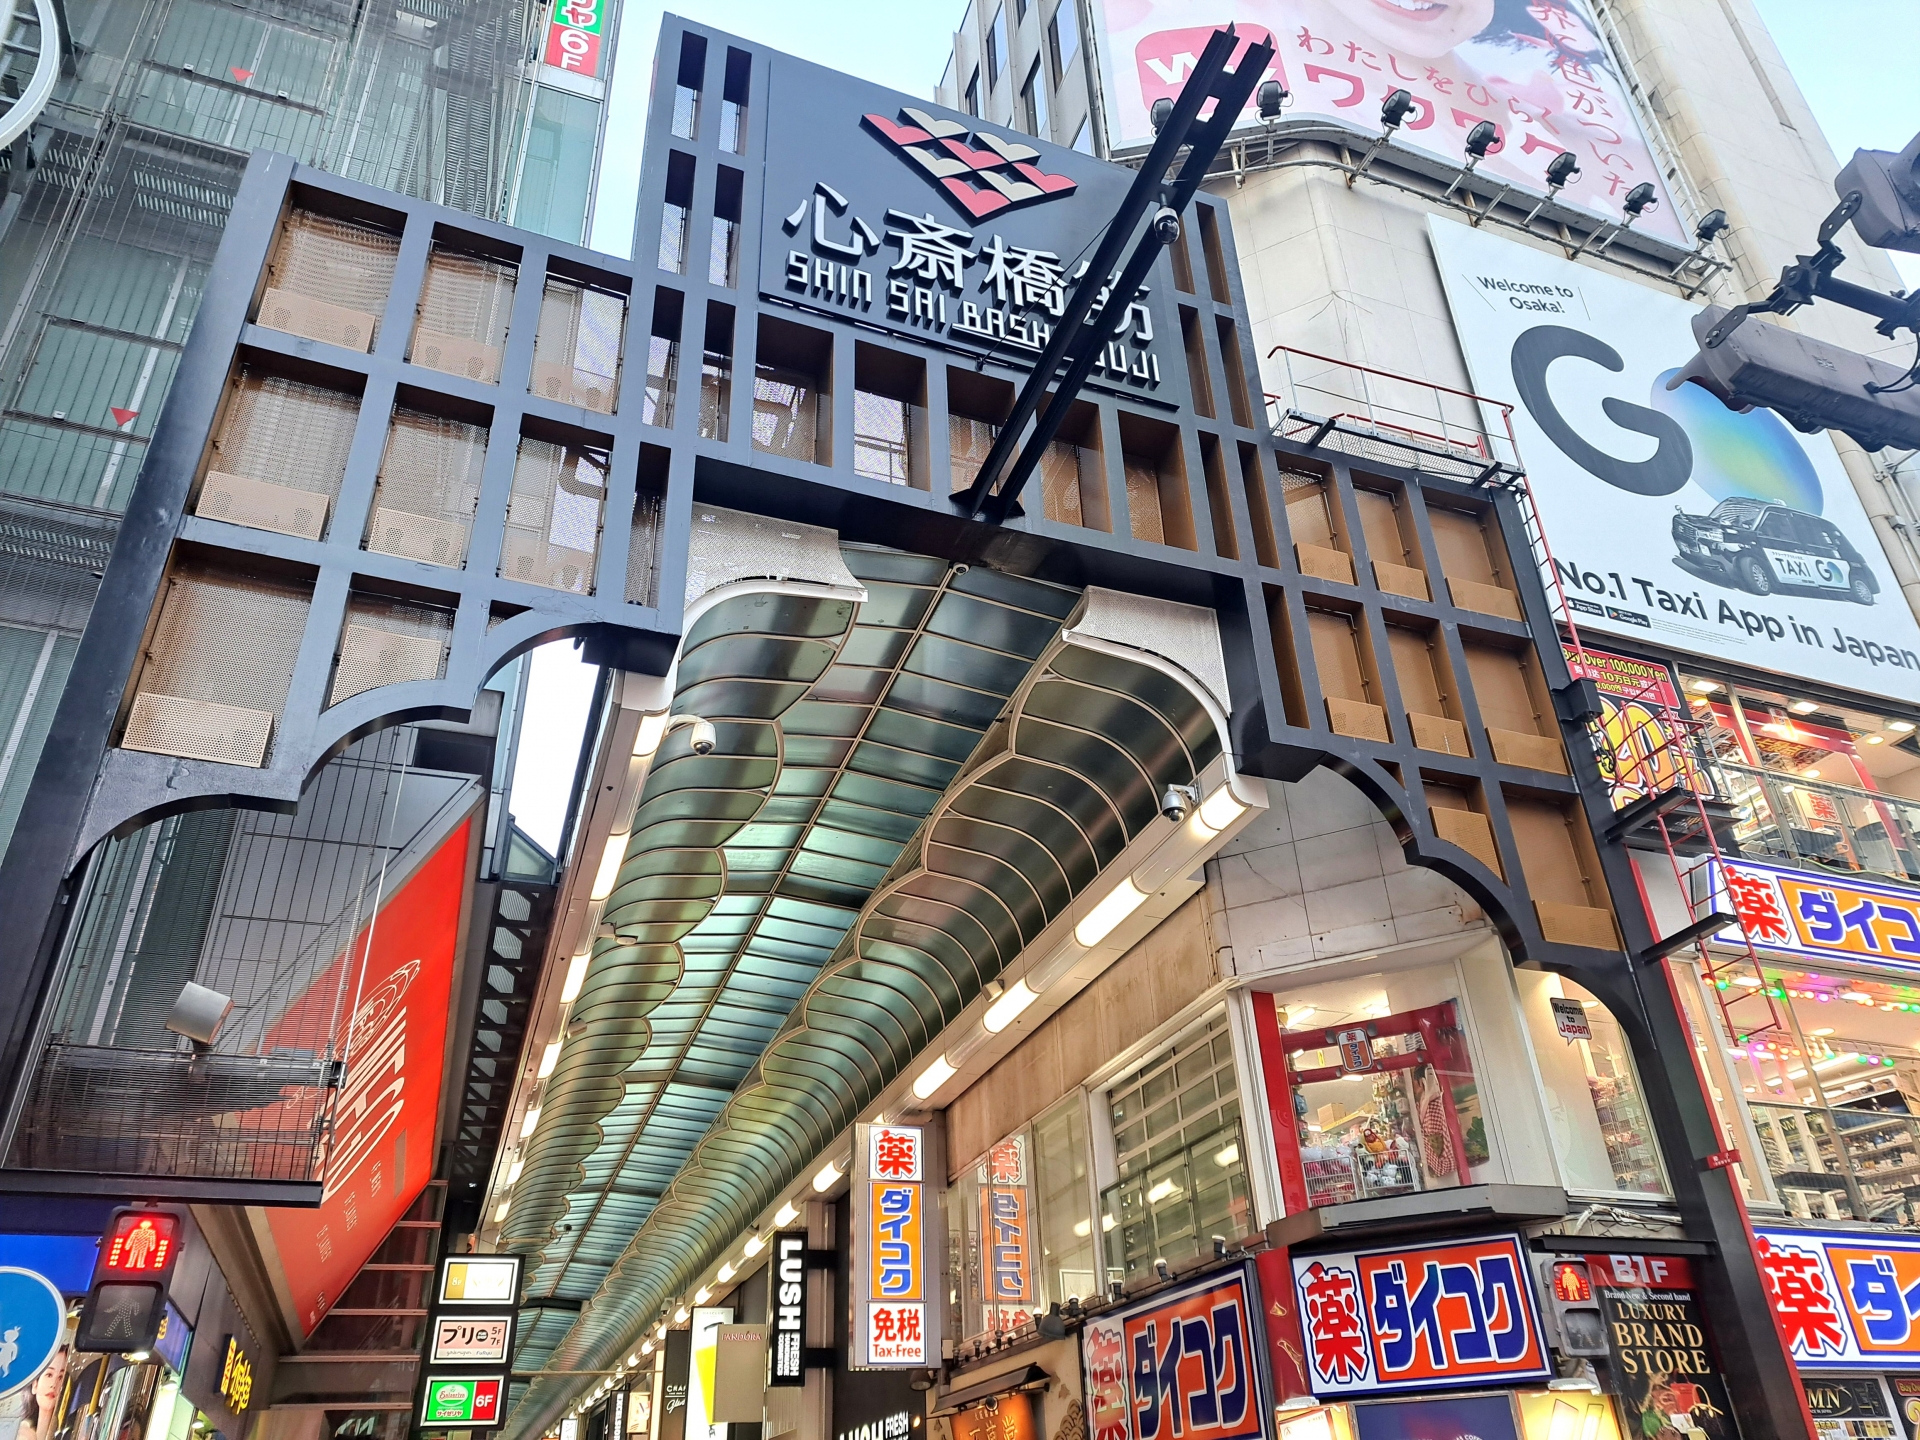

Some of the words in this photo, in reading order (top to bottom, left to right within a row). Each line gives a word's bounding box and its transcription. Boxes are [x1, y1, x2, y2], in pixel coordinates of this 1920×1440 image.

[560, 29, 590, 69] 6F
[1296, 26, 1560, 135] わたしをひらく
[787, 249, 873, 306] SHIN
[889, 280, 947, 328] SAI
[954, 300, 1054, 348] BASH
[1477, 275, 1555, 298] Welcome
[1558, 285, 1574, 299] to
[1508, 295, 1567, 315] Osaka!
[1775, 557, 1812, 578] TAXI
[1552, 557, 1628, 601] No.1
[1631, 577, 1709, 621] Taxi
[1718, 599, 1786, 643] App
[1788, 614, 1824, 650] in
[1832, 628, 1920, 673] Japan
[1562, 648, 1581, 664] Buy
[1584, 653, 1607, 668] Over
[1609, 658, 1649, 678] 100,000
[1648, 666, 1668, 682] Yen
[1721, 865, 1789, 943] 薬
[1797, 888, 1920, 955] ダイコ
[1552, 1003, 1584, 1016] Welcome
[1566, 1015, 1576, 1023] to
[1560, 1020, 1590, 1035] Japan
[877, 1129, 915, 1177] 薬
[880, 1187, 913, 1295] ダイコク
[1609, 1254, 1669, 1283] B1F
[451, 1276, 463, 1287] 8F
[779, 1239, 803, 1330] LUSH
[1756, 1237, 1843, 1351] 薬
[1846, 1254, 1920, 1346] ダ
[1604, 1289, 1625, 1299] Brand
[1626, 1290, 1641, 1299] New
[1649, 1291, 1673, 1300] Second
[1673, 1292, 1692, 1301] hand
[1298, 1262, 1367, 1379] 薬
[1371, 1255, 1529, 1372] ダイコク
[1616, 1302, 1687, 1321] LUXURY
[443, 1325, 475, 1345] プリ
[491, 1326, 502, 1335] 5F
[873, 1308, 921, 1342] 免税
[1612, 1322, 1704, 1347] BRAND
[490, 1337, 501, 1346] 7F
[790, 1332, 800, 1376] FRESH
[873, 1344, 921, 1358] Tax-Free
[1086, 1326, 1128, 1440] 薬
[1133, 1299, 1248, 1440] ダイコク
[1621, 1349, 1711, 1375] STORE
[475, 1395, 494, 1408] 6F
[1806, 1387, 1841, 1409] MN
[436, 1409, 463, 1418] サイゼリヤ
[885, 1410, 909, 1439] FRESH
